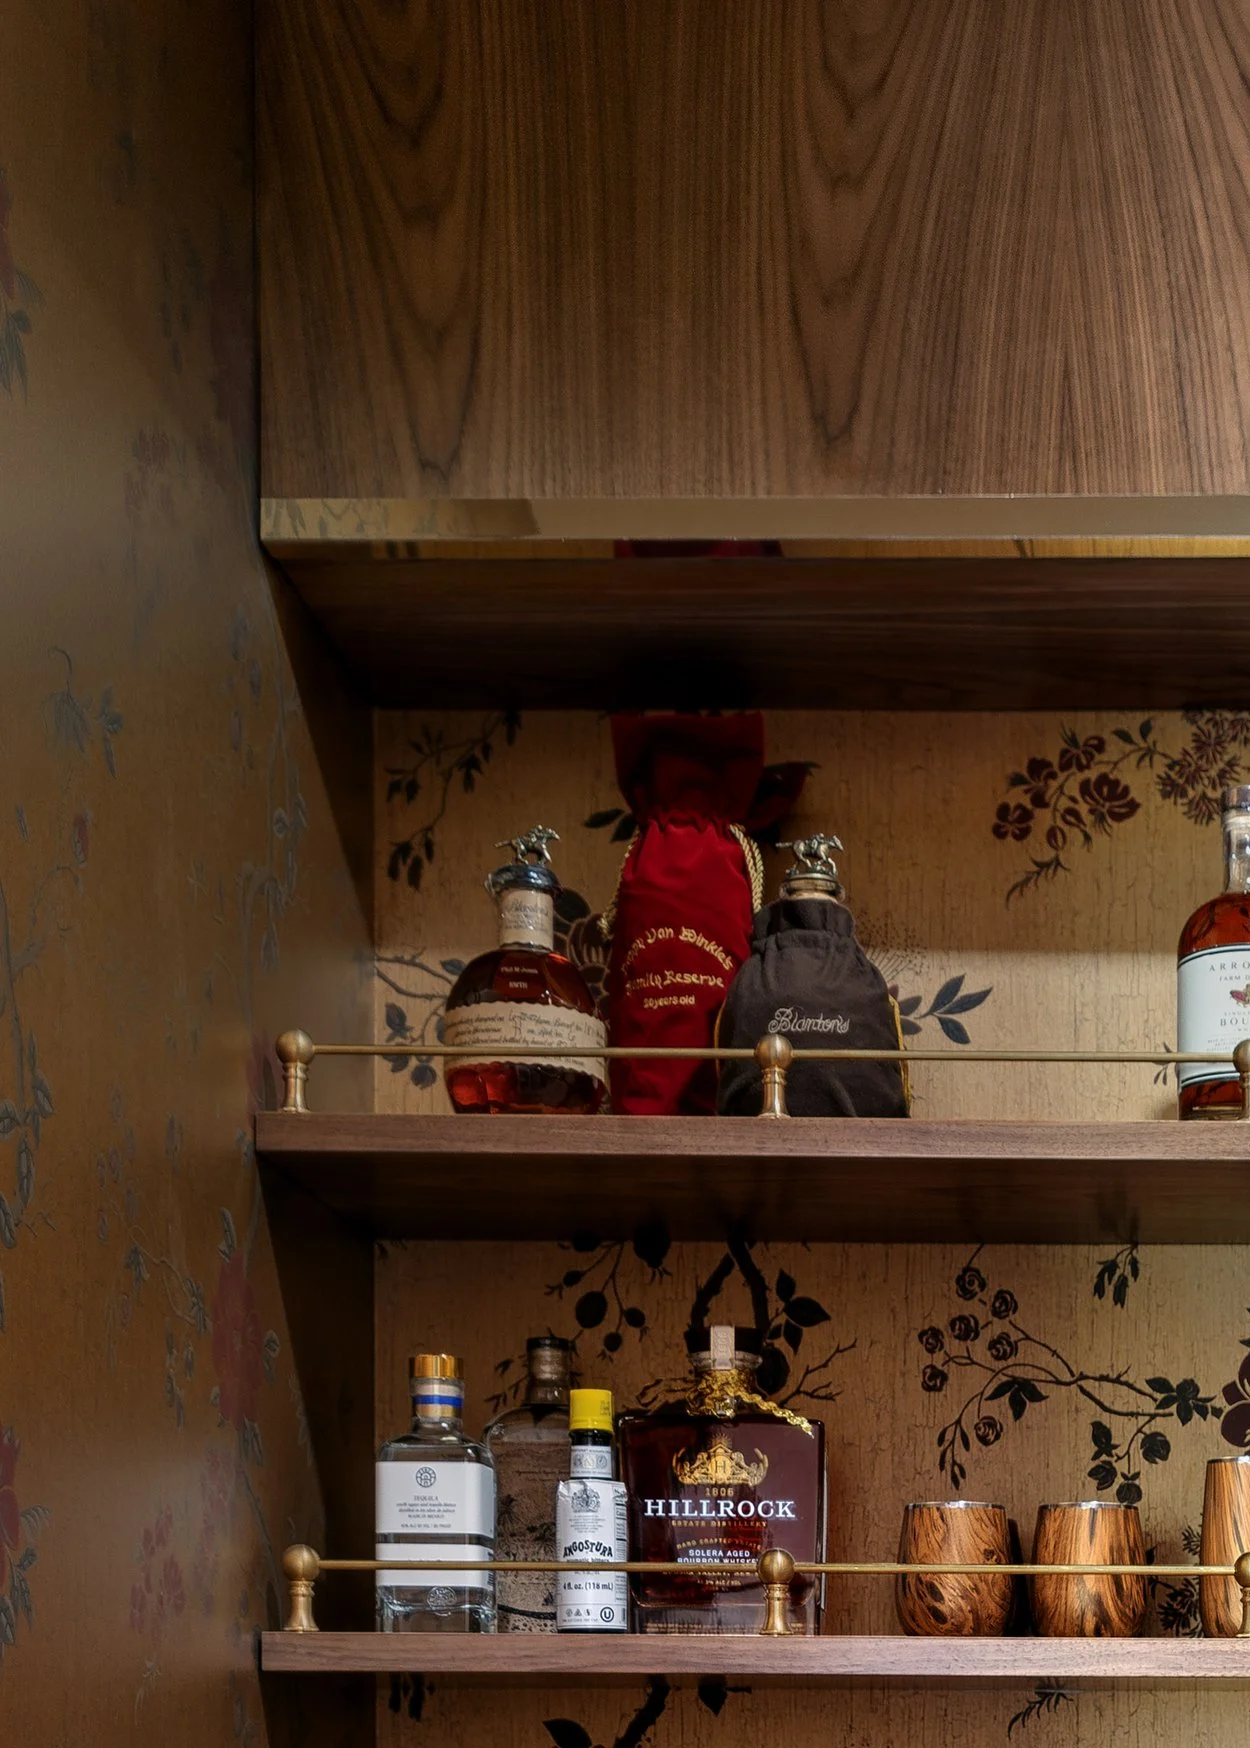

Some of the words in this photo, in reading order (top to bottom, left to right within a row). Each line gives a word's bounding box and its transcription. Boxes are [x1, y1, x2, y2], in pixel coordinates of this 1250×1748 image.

[645, 926, 674, 944] Van
[663, 969, 725, 989] Reserve
[1219, 974, 1241, 982] FARM
[679, 994, 696, 1006] old
[767, 1005, 850, 1035] Blanton's
[705, 1487, 735, 1498] 1806
[643, 1499, 796, 1518] HILLROCK
[563, 1539, 613, 1558] ANGOSTURA
[688, 1549, 724, 1557] SOLERA
[727, 1550, 750, 1558] AGED
